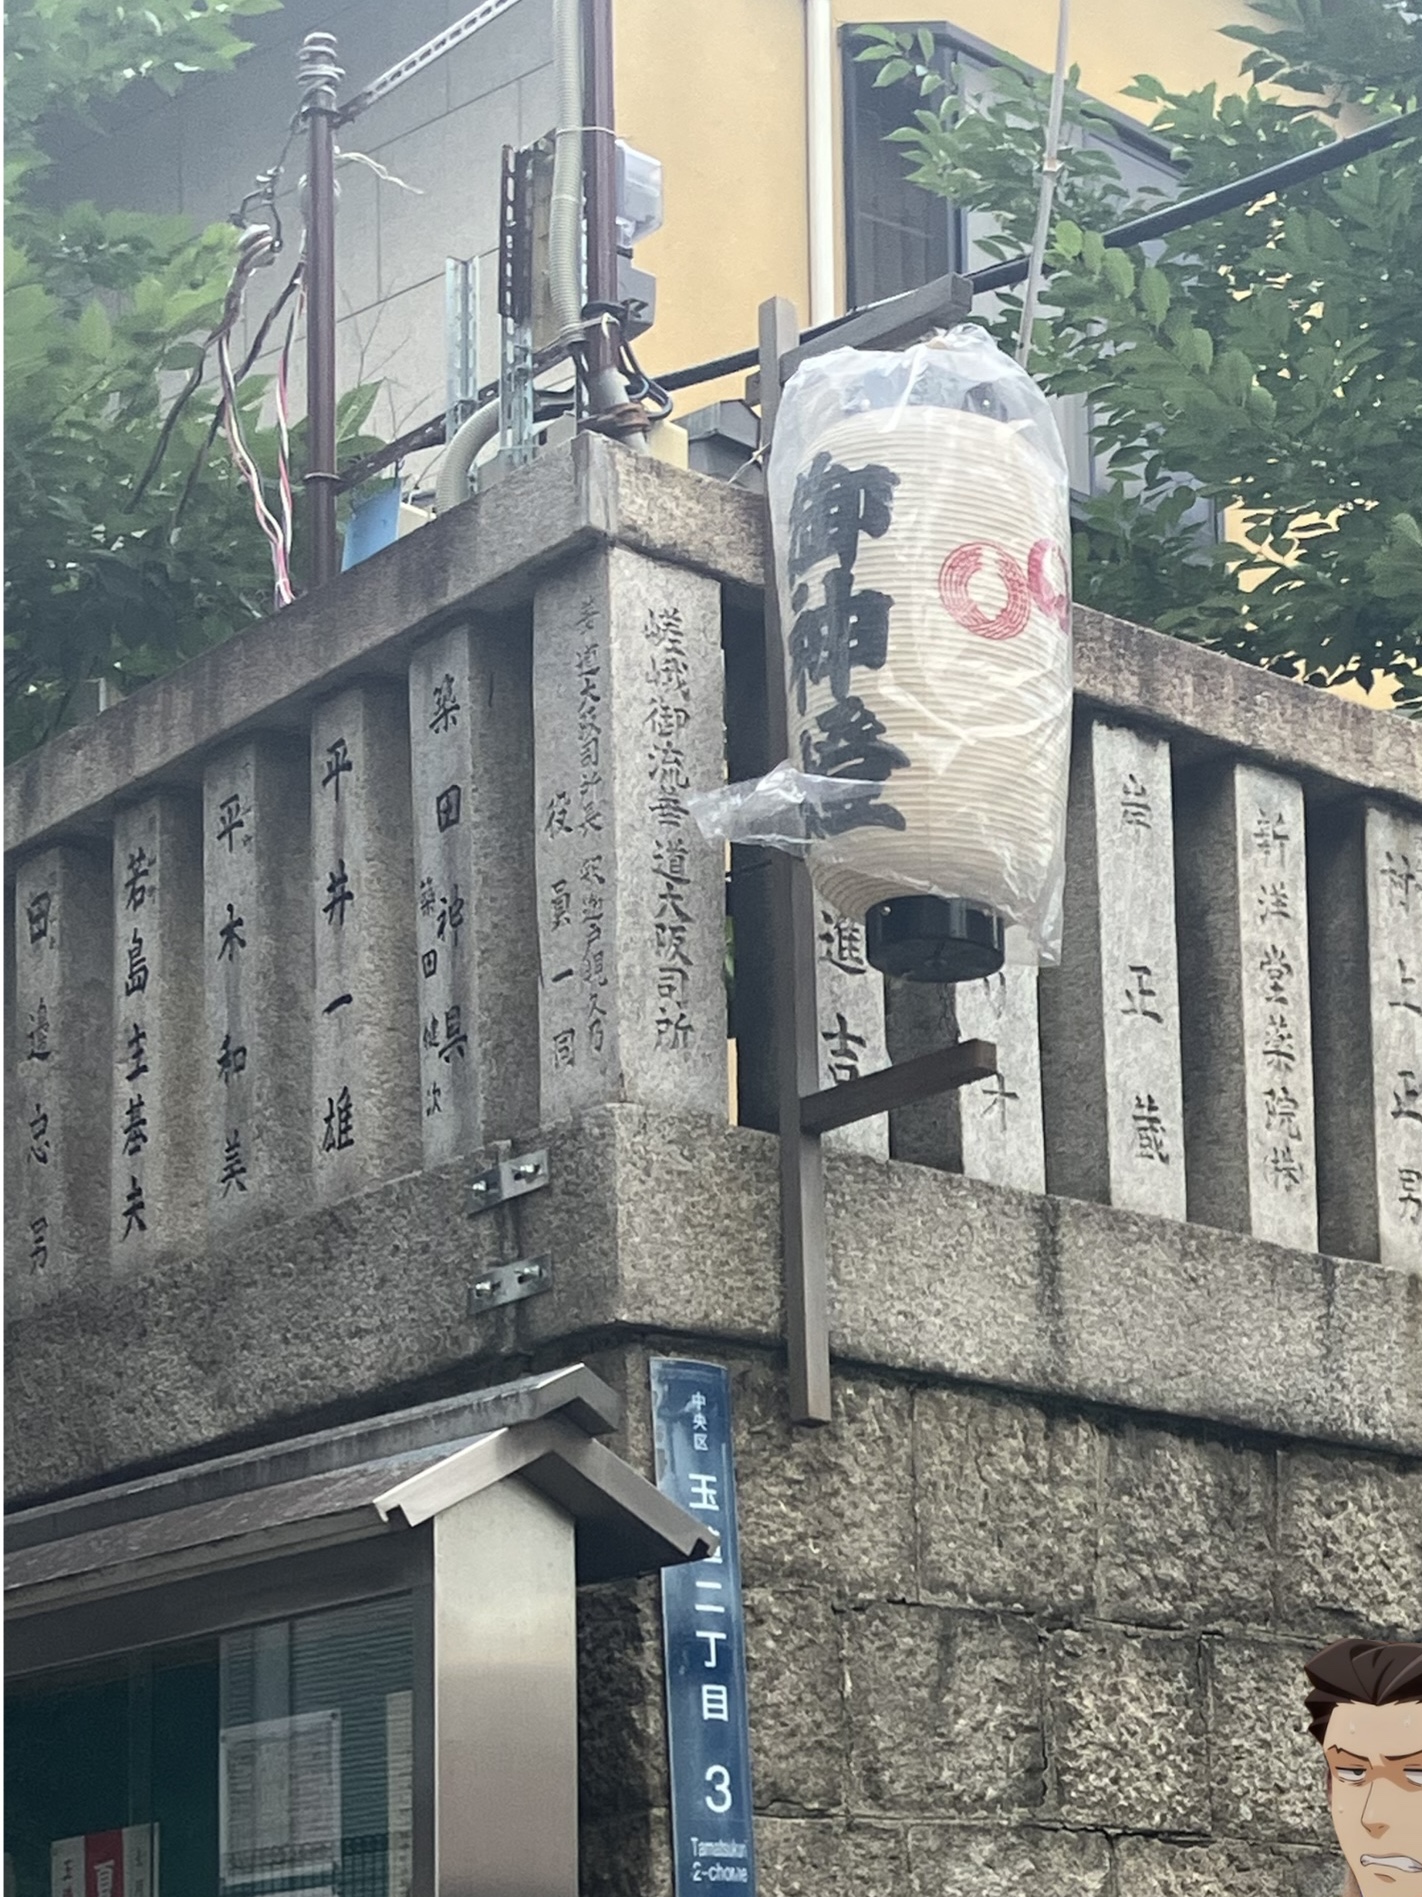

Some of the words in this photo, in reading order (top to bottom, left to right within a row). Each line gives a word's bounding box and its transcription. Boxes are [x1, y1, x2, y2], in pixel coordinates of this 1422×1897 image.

[322, 737, 354, 1153] 平井一雄
[217, 793, 247, 1198] 平木和美
[691, 1391, 708, 1451] 中央区
[705, 1764, 732, 1813] 3
[692, 1861, 748, 1883] 2-chome
